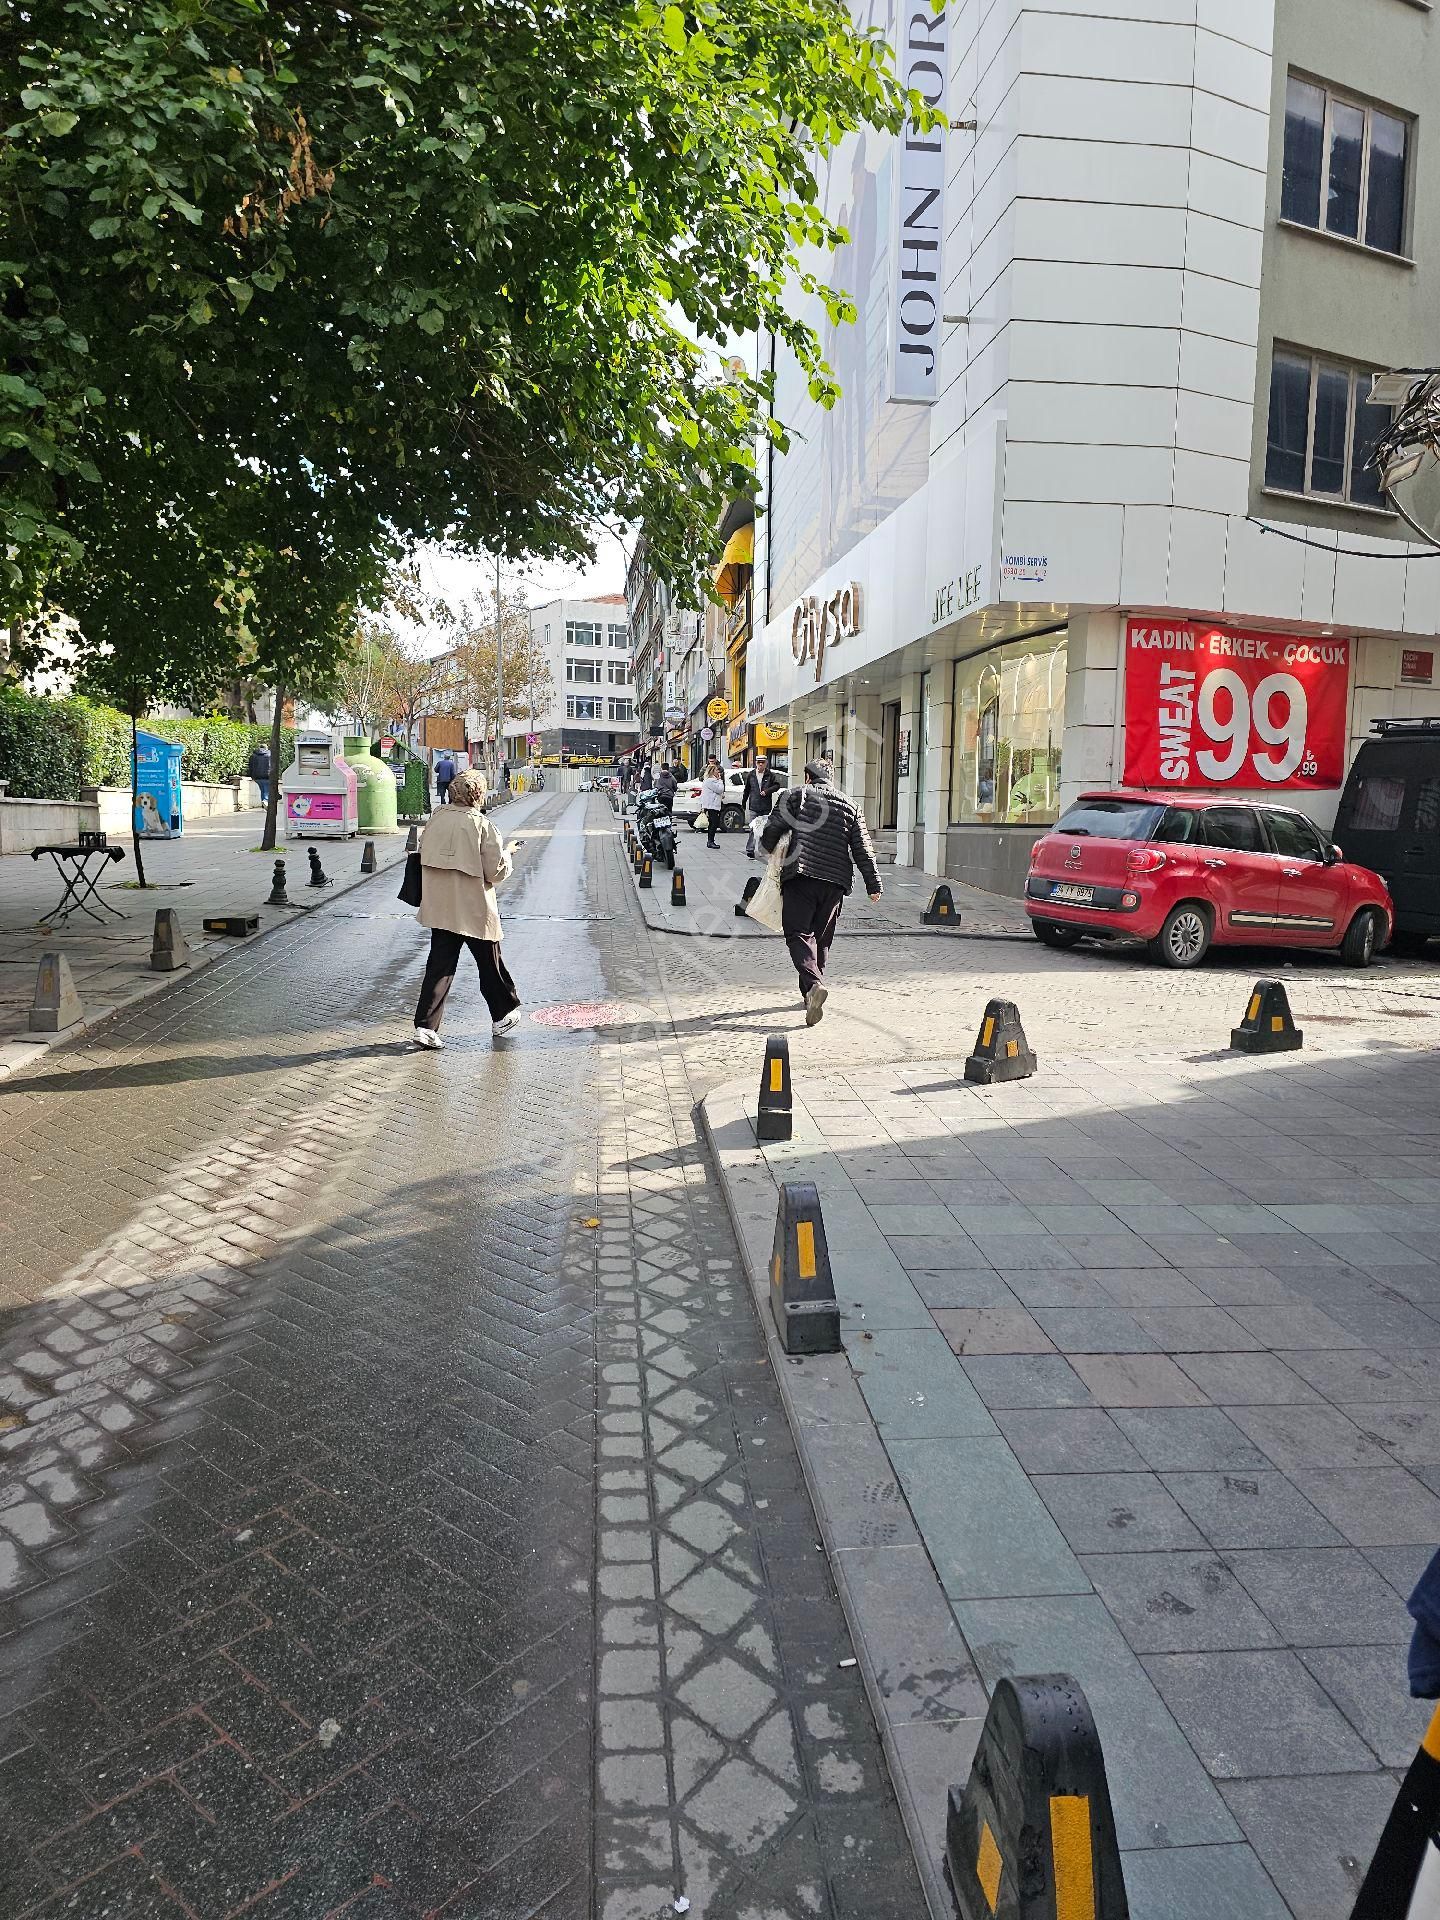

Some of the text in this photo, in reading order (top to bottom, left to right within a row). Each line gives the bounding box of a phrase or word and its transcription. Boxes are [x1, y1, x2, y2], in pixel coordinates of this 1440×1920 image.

[899, 186, 941, 377] JOHN
[1131, 629, 1195, 651] KADIN
[1209, 635, 1270, 660] ERKEK
[1283, 644, 1346, 666] ÇOCUK
[1159, 662, 1196, 781] SWEAT
[1195, 668, 1308, 782] 99
